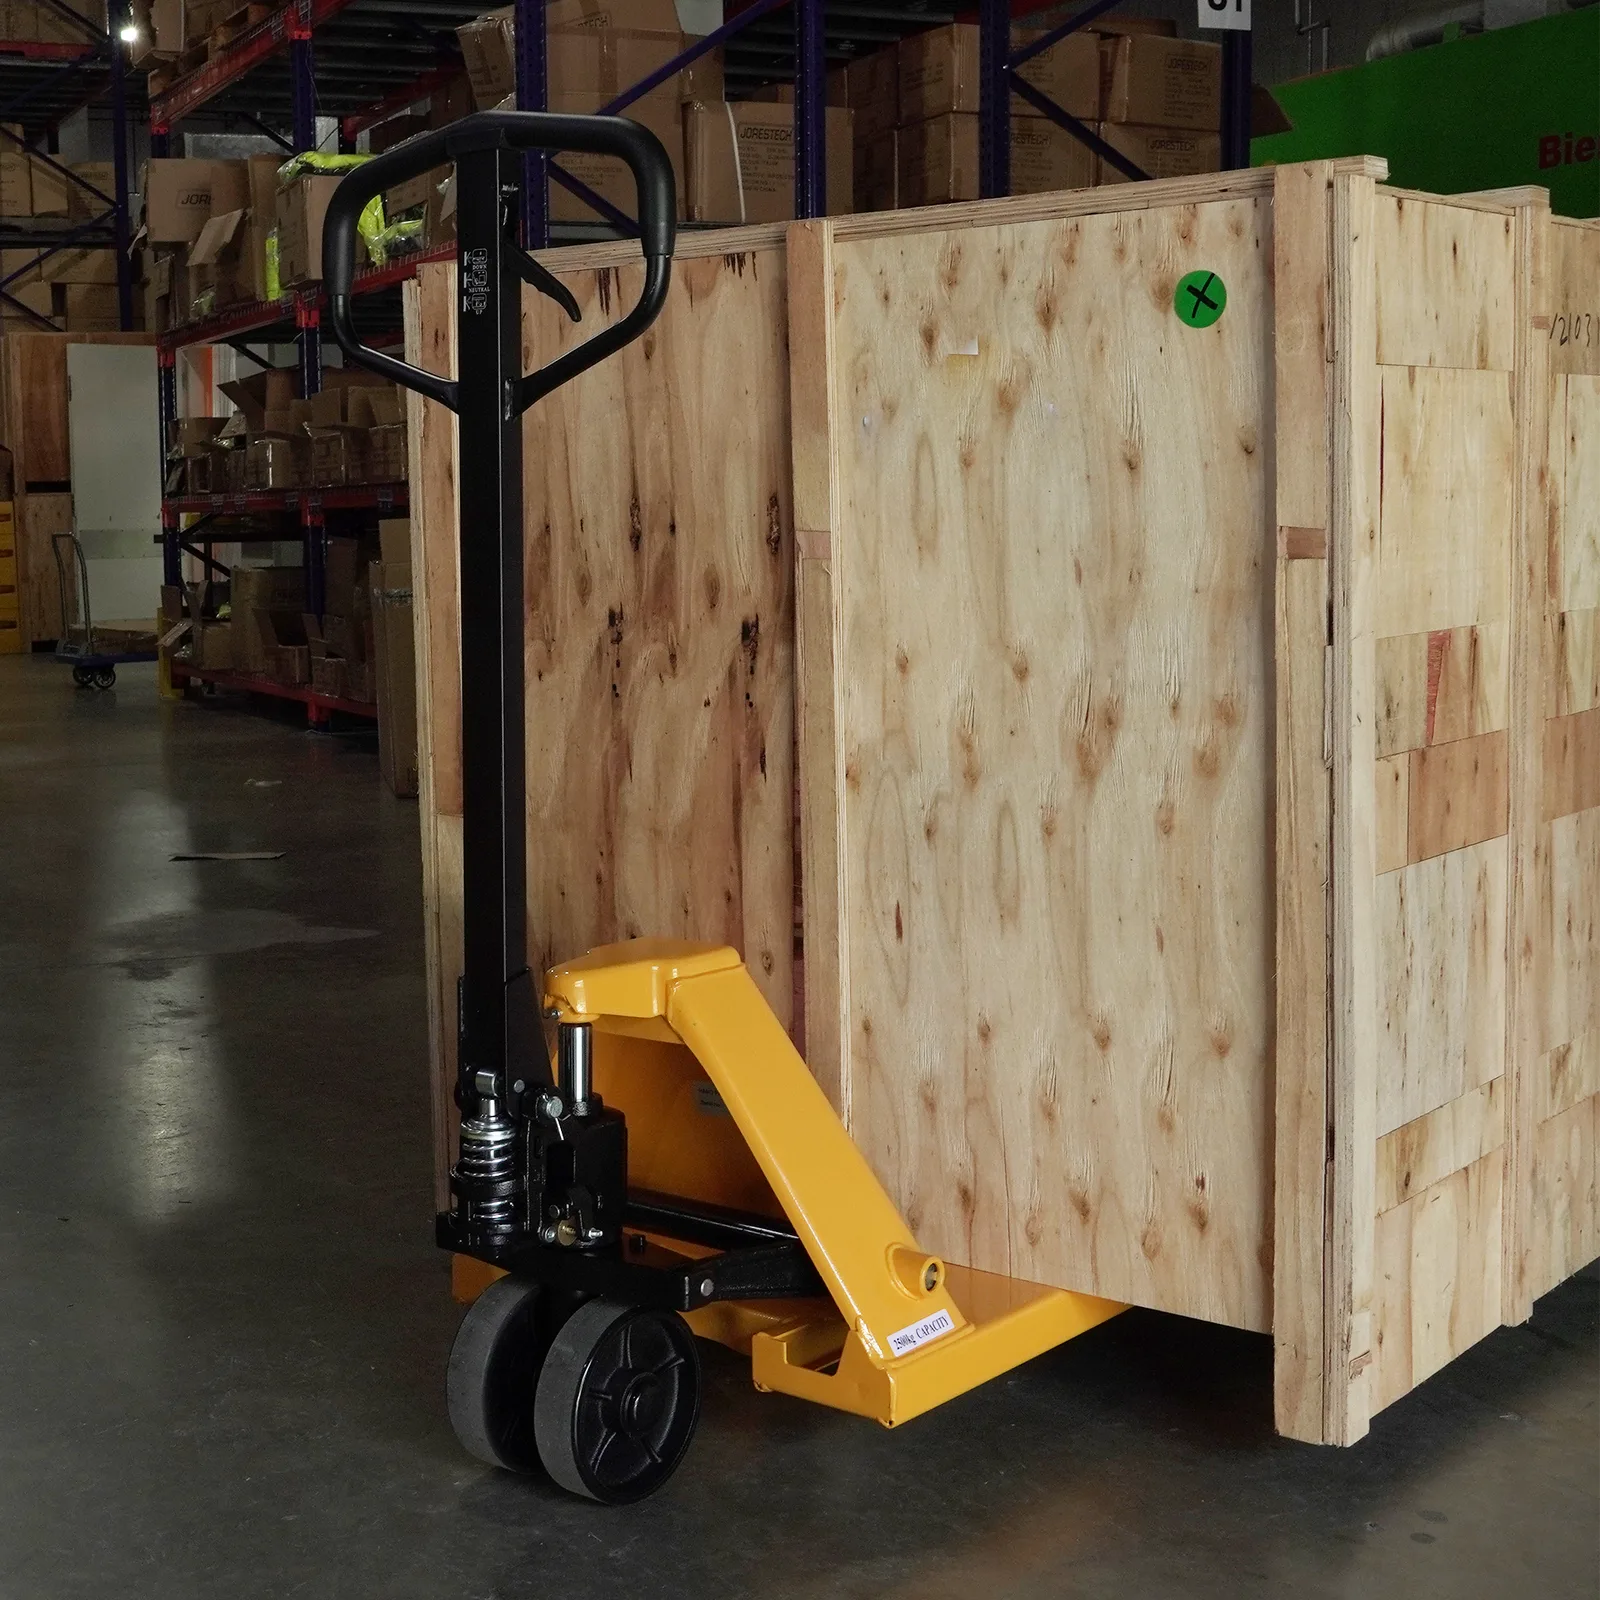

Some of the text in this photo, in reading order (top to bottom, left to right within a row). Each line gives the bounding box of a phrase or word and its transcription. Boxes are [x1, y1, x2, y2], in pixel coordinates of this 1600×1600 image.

[740, 127, 792, 141] JORESTECH
[1149, 139, 1196, 151] JORESTECH
[1538, 131, 1600, 169] Bie
[915, 1315, 949, 1339] CAPACITY
